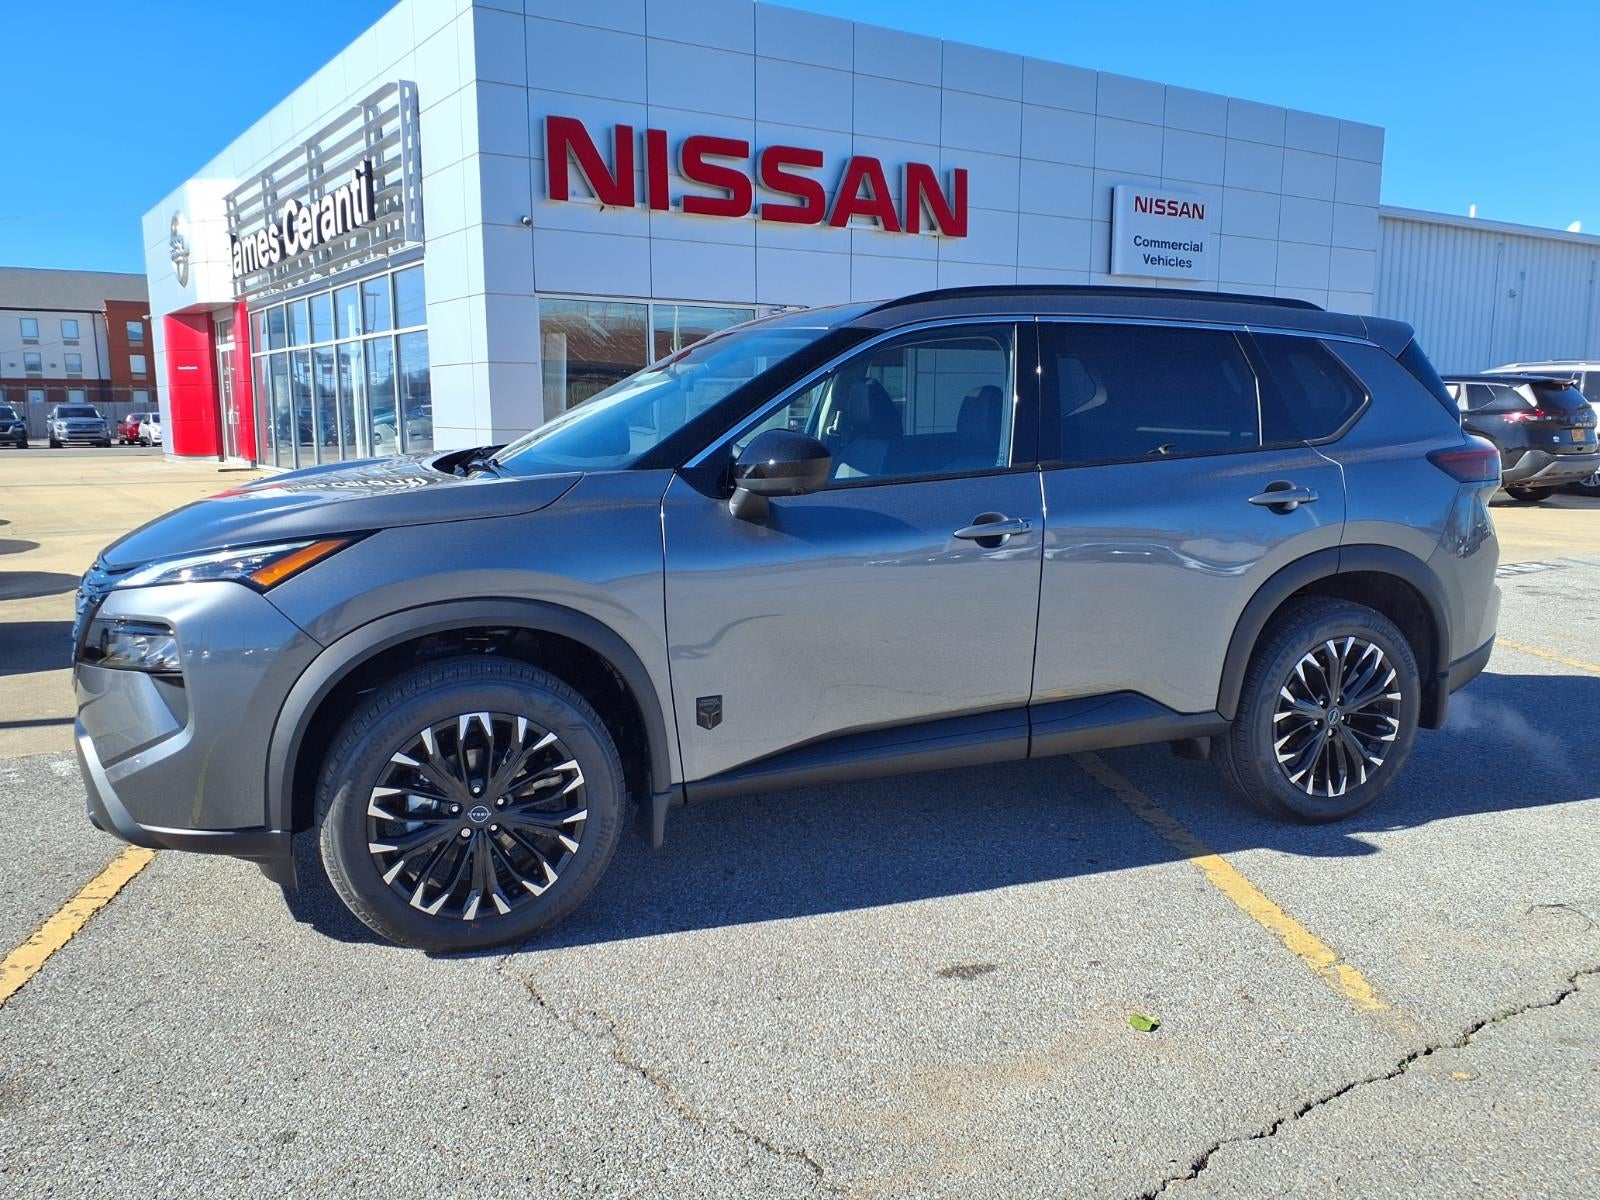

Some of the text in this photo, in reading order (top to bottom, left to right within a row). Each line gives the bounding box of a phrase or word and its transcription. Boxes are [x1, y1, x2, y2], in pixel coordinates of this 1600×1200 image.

[544, 115, 968, 238] NISSAN
[283, 160, 372, 256] Ceranti
[1134, 195, 1205, 220] NISSAN
[1133, 235, 1203, 253] Commercial
[1142, 254, 1193, 269] Vehicles
